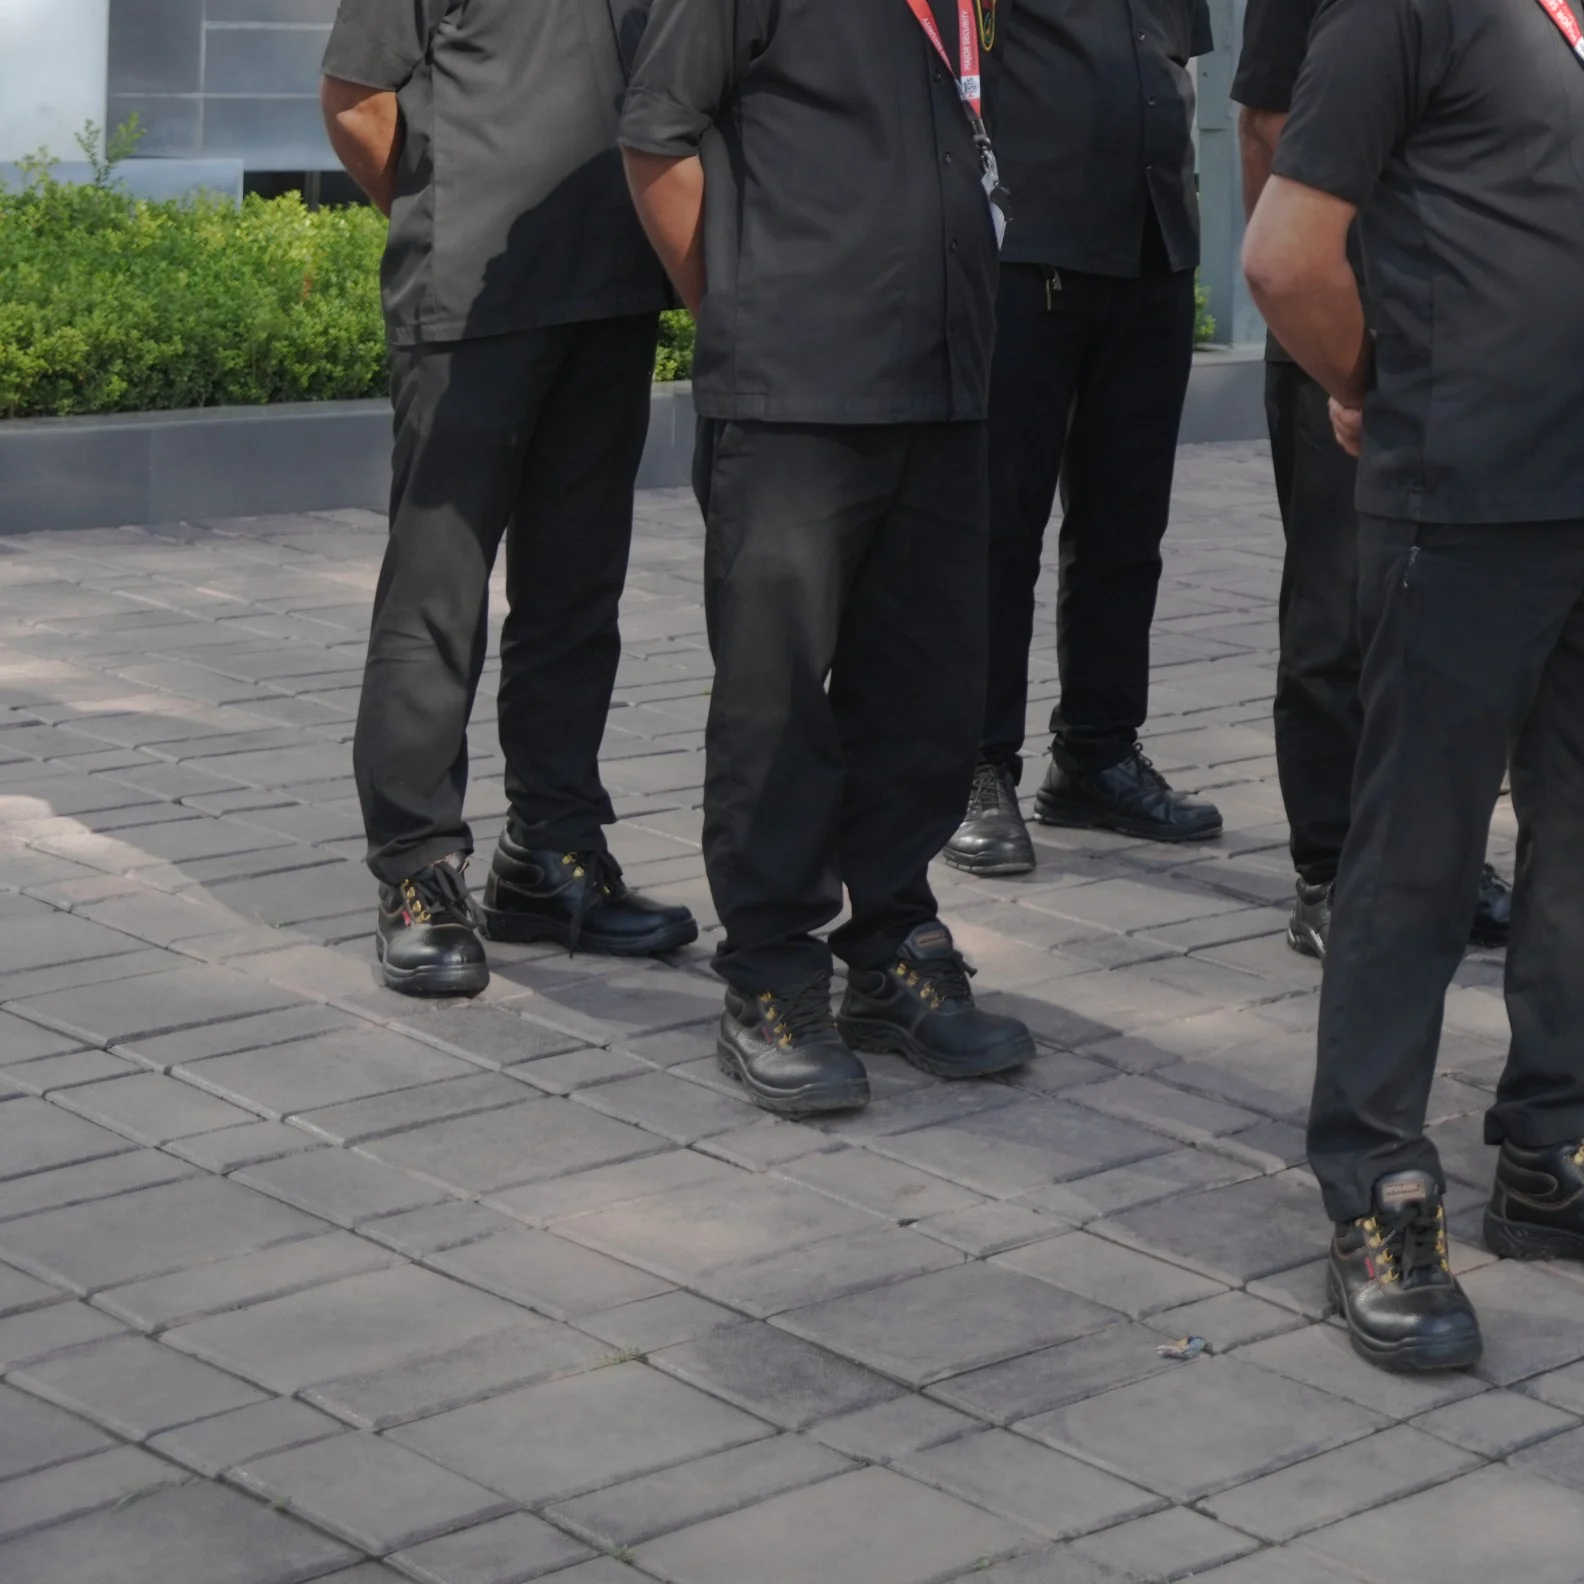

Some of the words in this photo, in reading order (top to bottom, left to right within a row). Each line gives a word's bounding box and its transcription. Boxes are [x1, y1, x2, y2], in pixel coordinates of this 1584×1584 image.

[962, 9, 972, 44] SECURITY
[1556, 10, 1578, 43] MAJOR
[963, 46, 973, 71] MAJOR
